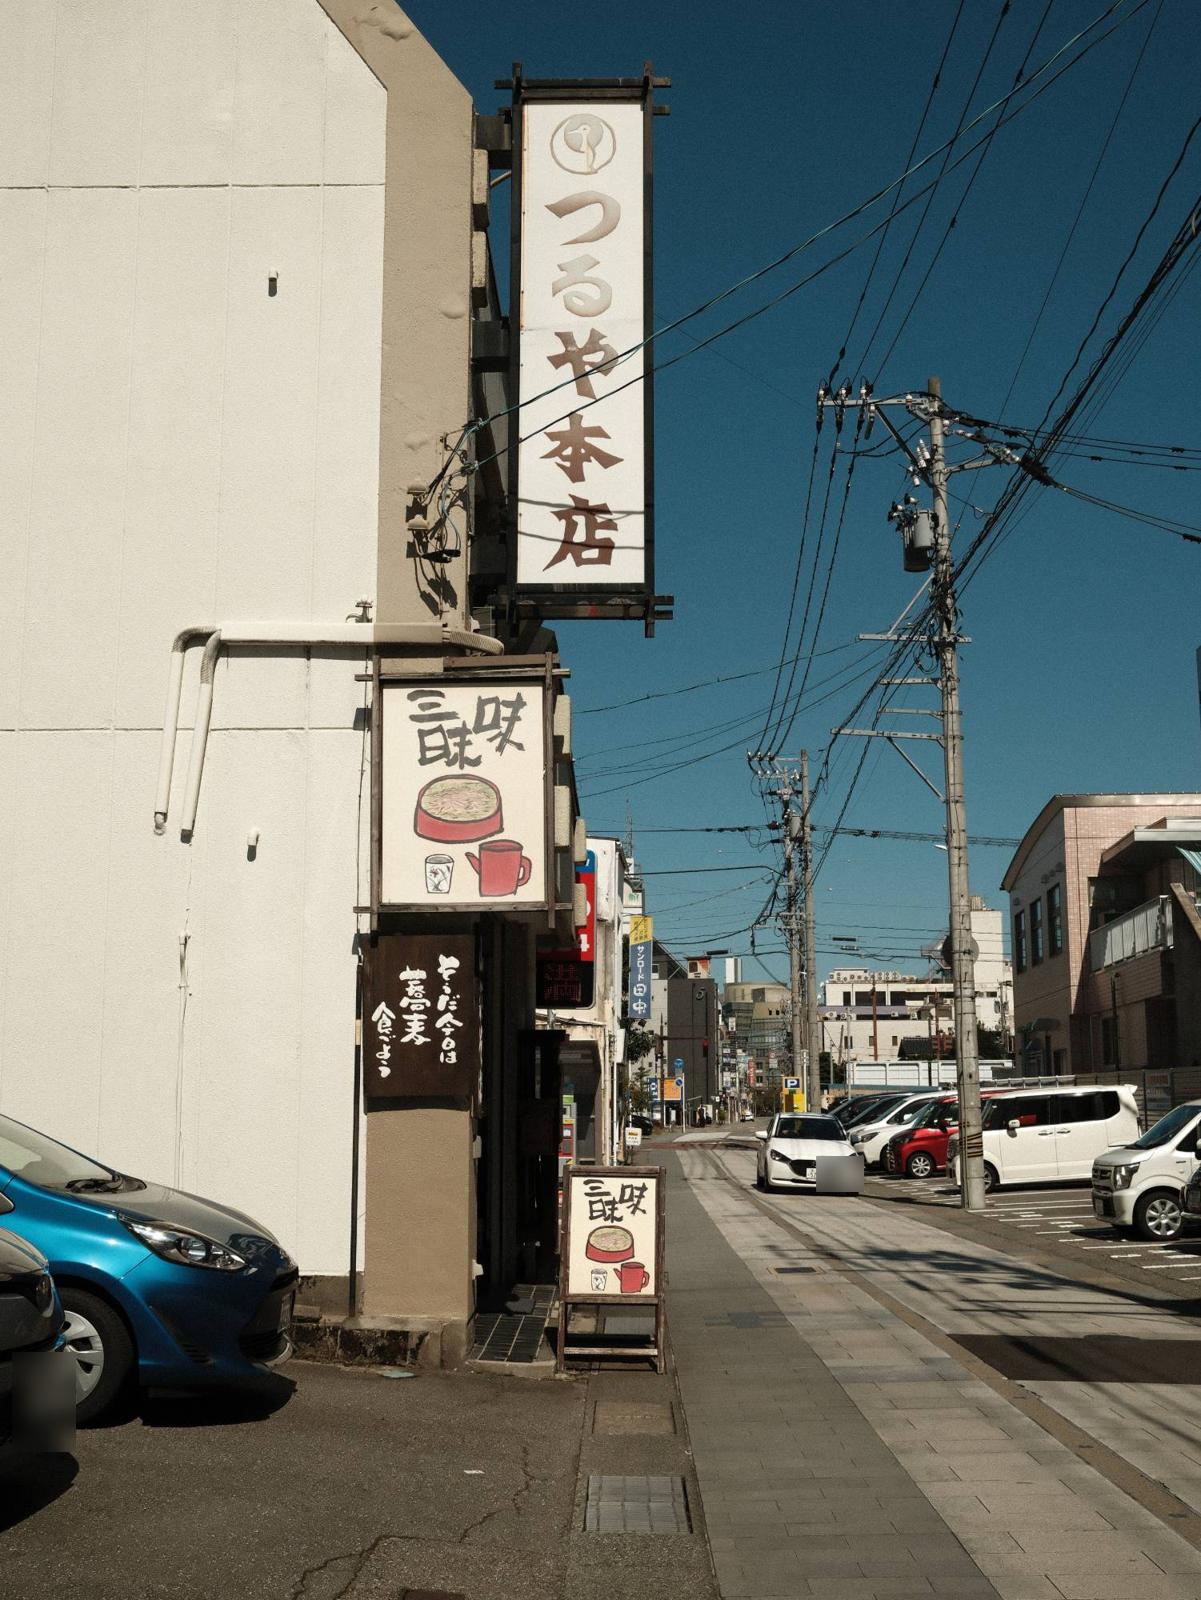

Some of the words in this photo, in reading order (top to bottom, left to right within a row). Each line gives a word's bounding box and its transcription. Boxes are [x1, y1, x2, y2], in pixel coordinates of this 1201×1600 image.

[539, 190, 625, 572] つるや本店
[632, 945, 648, 1015] サンロード田中
